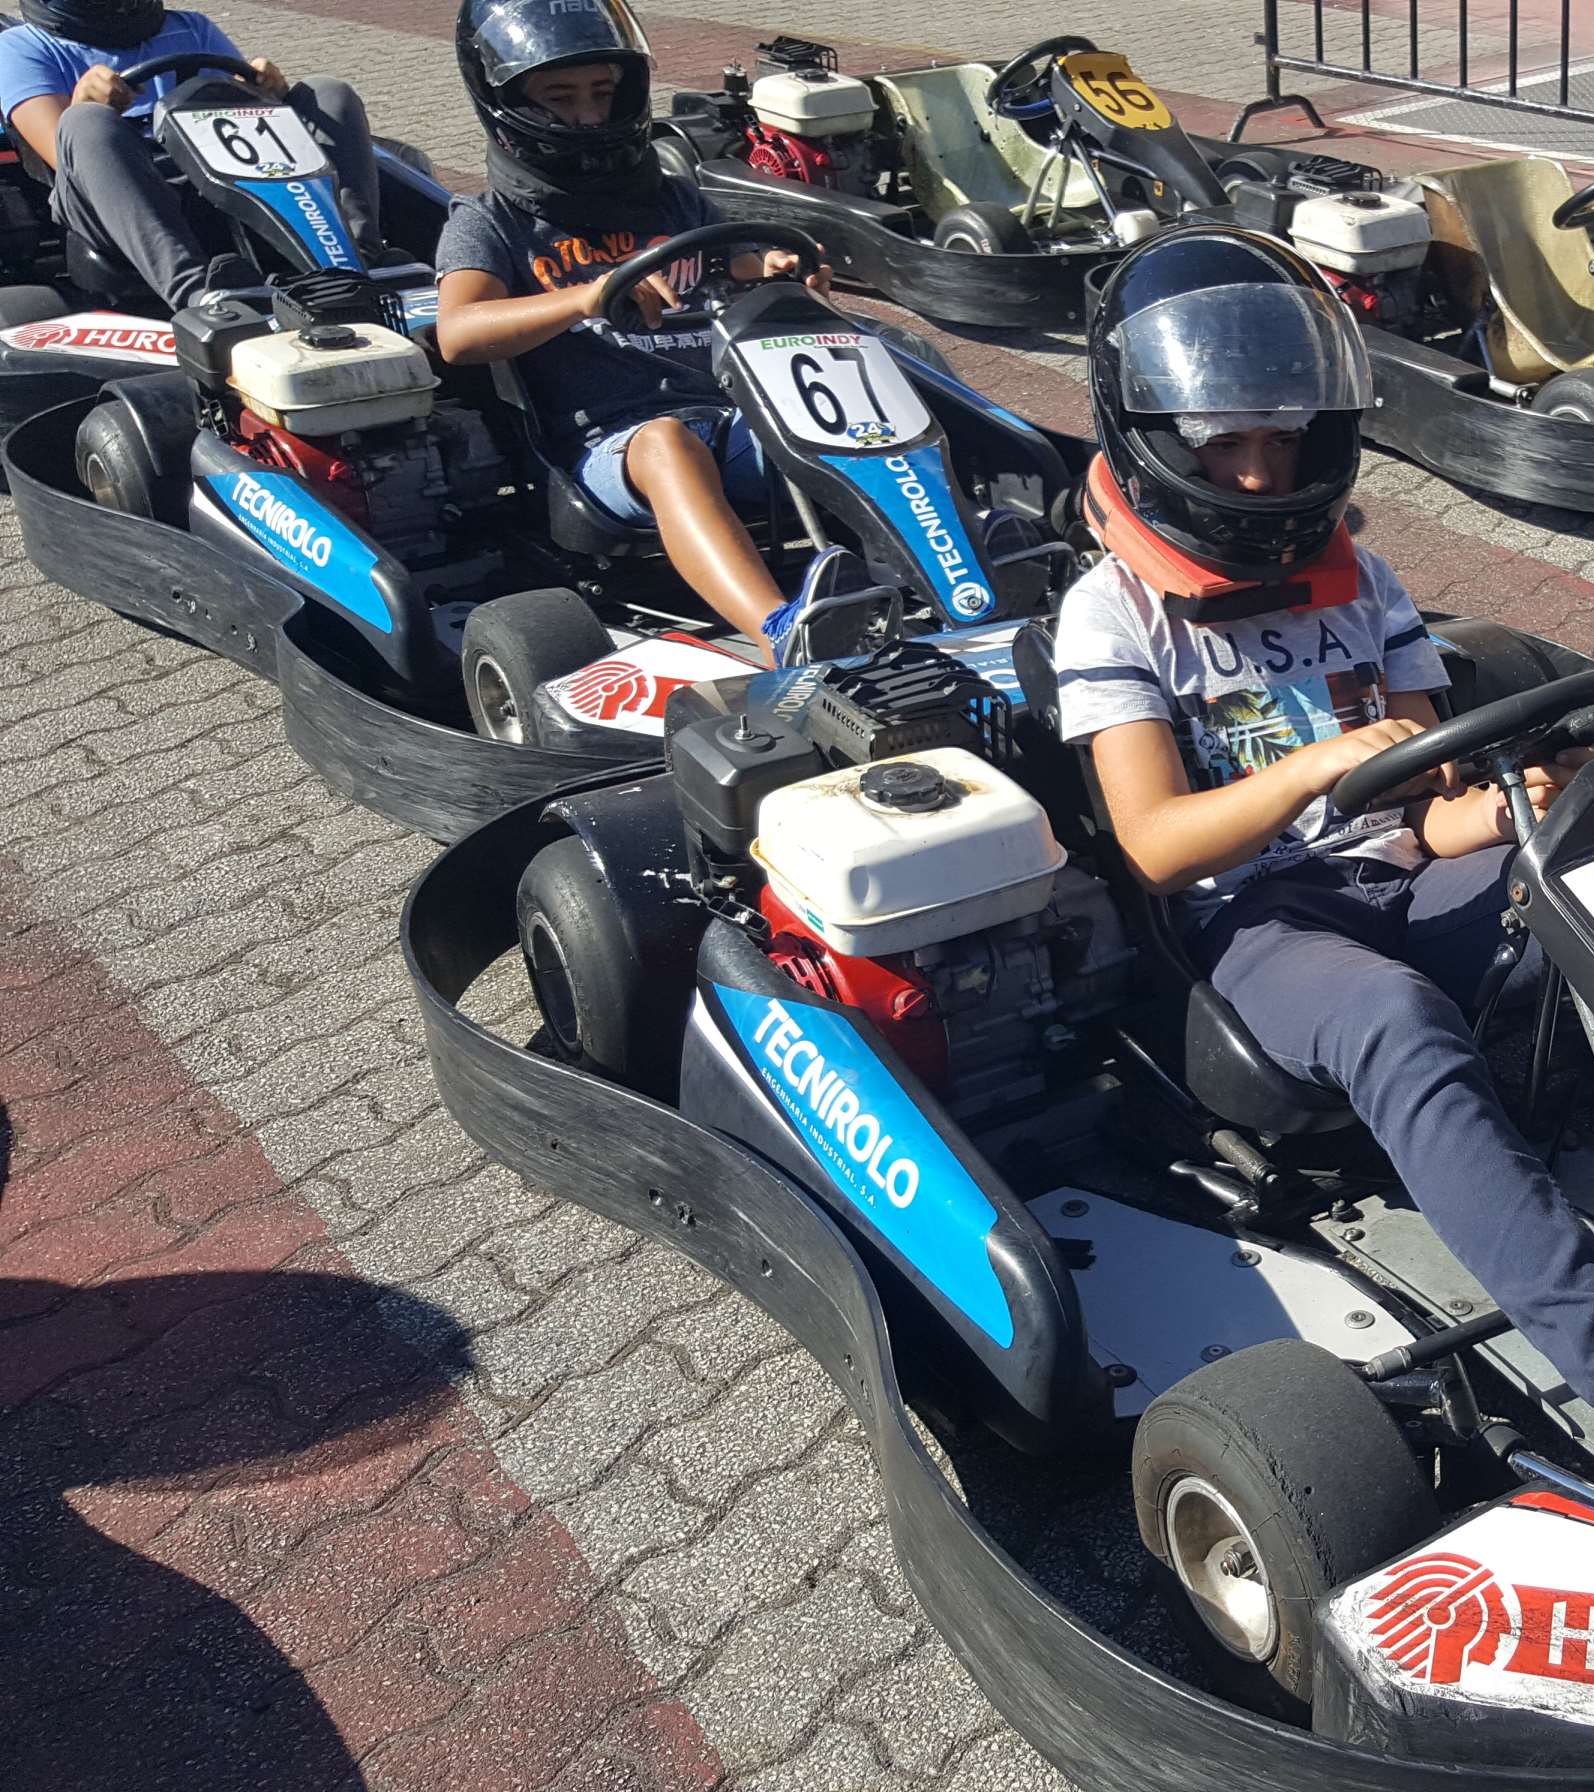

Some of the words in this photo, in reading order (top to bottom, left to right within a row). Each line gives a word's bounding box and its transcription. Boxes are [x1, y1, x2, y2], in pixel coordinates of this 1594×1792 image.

[1079, 71, 1155, 116] 56
[213, 117, 297, 166] 61
[287, 182, 348, 267] TECNIROLO
[84, 329, 177, 353] HURO
[761, 335, 861, 350] EUROINDY
[791, 348, 889, 435] 67
[851, 422, 882, 438] 24
[232, 472, 332, 567] TECNIROLO
[885, 455, 968, 585] TECNIROLO
[1202, 618, 1353, 678] U.S.A
[754, 998, 920, 1209] TECNIROLO
[761, 1067, 808, 1126] ENGENHARIA
